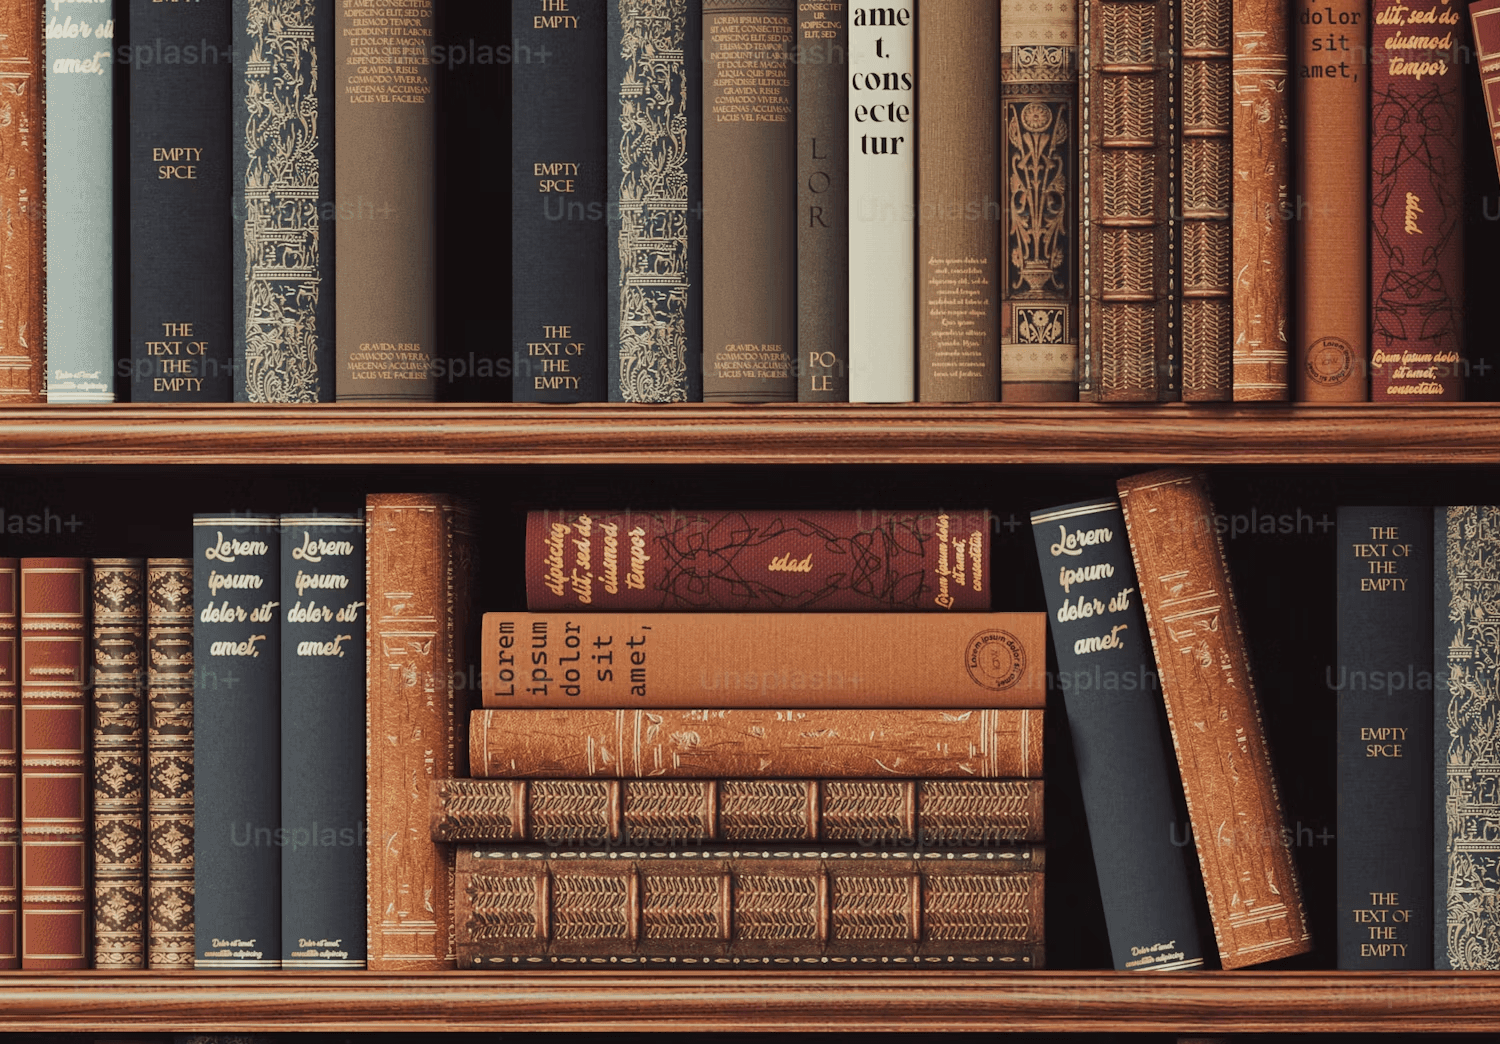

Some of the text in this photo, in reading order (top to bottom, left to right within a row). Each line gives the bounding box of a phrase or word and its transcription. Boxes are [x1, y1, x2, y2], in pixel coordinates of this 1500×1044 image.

[854, 3, 913, 30] ame
[1376, 5, 1459, 26] elit, sed do
[877, 38, 889, 58] t.
[1385, 31, 1452, 50] eiusmod
[852, 70, 913, 91] cons
[1389, 56, 1448, 80] tempor
[855, 101, 913, 122] ecte
[862, 134, 904, 154] tur
[1405, 192, 1423, 234] sdad
[810, 352, 835, 367] PO
[811, 375, 832, 391] LE
[1051, 525, 1112, 556] Lorem
[1370, 527, 1398, 539] THE
[206, 531, 268, 562] Lorem
[544, 523, 571, 595] dipiscing
[571, 514, 593, 603] elit, sed do
[598, 522, 618, 594] eiusmod
[625, 527, 650, 589] tempor
[1353, 544, 1411, 557] TEXT OF
[769, 552, 813, 572] sdad
[935, 515, 955, 607] Lorem ipsum dolor
[952, 537, 966, 585] sit amet,
[968, 530, 982, 591] consectetur
[1368, 561, 1396, 573] THE
[208, 570, 263, 595] ipsum
[1060, 563, 1114, 593] ipsum
[1361, 579, 1404, 591] EMPTY
[201, 601, 279, 623] dolor sit
[1058, 588, 1133, 622] dolor sit
[210, 635, 265, 657] amet,
[1074, 625, 1127, 655] amet,
[495, 622, 514, 701] Lorem
[526, 622, 552, 696] ipsum
[559, 622, 581, 696] dolor
[592, 636, 613, 681] sit
[626, 626, 651, 697] amet,
[1361, 728, 1405, 740] EMPTY
[1367, 745, 1402, 757] SPCE
